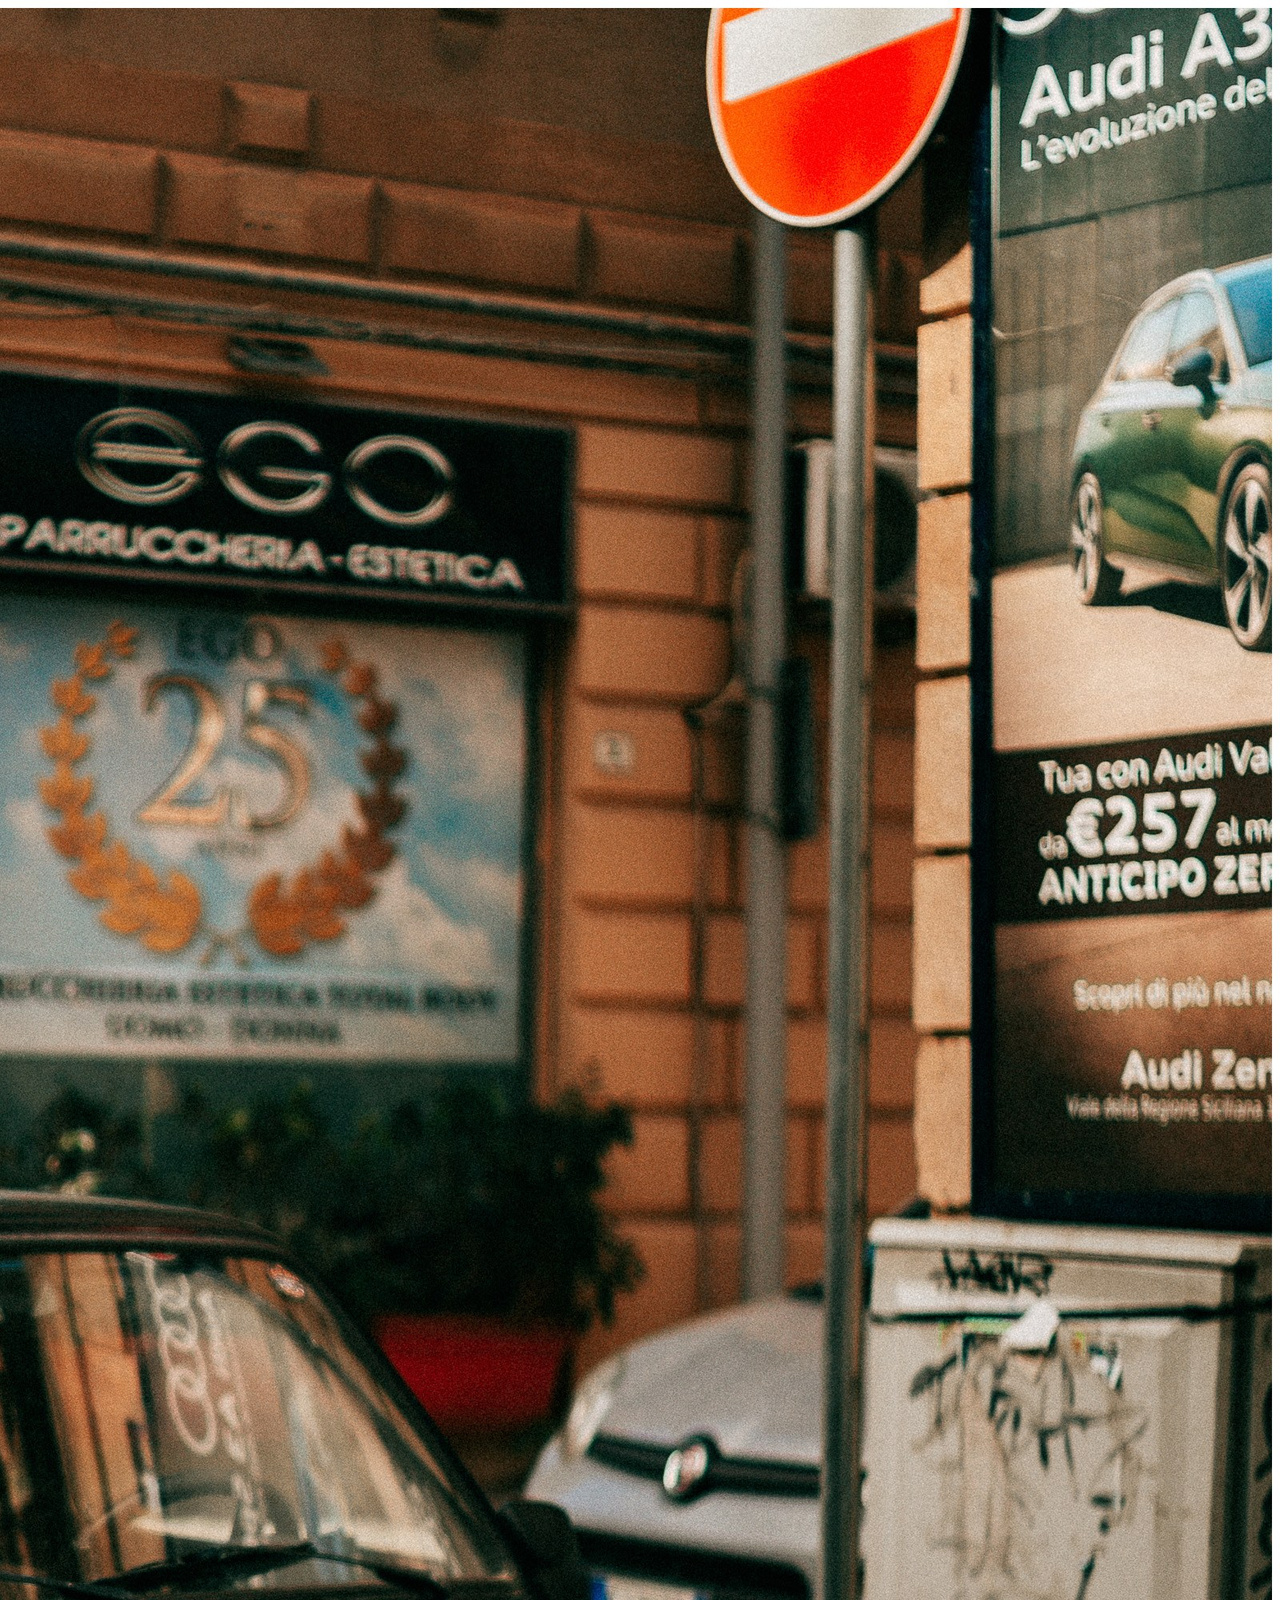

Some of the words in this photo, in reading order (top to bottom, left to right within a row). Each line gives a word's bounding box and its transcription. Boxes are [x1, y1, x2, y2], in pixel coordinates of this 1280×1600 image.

[1019, 29, 1164, 128] Audi
[1180, 8, 1272, 78] A3
[1021, 94, 1217, 172] L'evoluzione
[347, 543, 524, 590] ESTETICA
[177, 615, 284, 664] EGO
[140, 671, 312, 832] 25
[1038, 759, 1092, 794] Tua
[1096, 757, 1149, 791] con
[1153, 747, 1222, 786] Audi
[1038, 831, 1068, 860] da
[1066, 787, 1215, 859] €257
[1216, 814, 1241, 847] al
[1037, 856, 1207, 905] ANTICIPO
[1073, 978, 1143, 1013] Scopri
[1145, 976, 1168, 1009] di
[1172, 975, 1210, 1012] più
[1213, 974, 1252, 1006] nel
[1121, 1049, 1201, 1090] Audi
